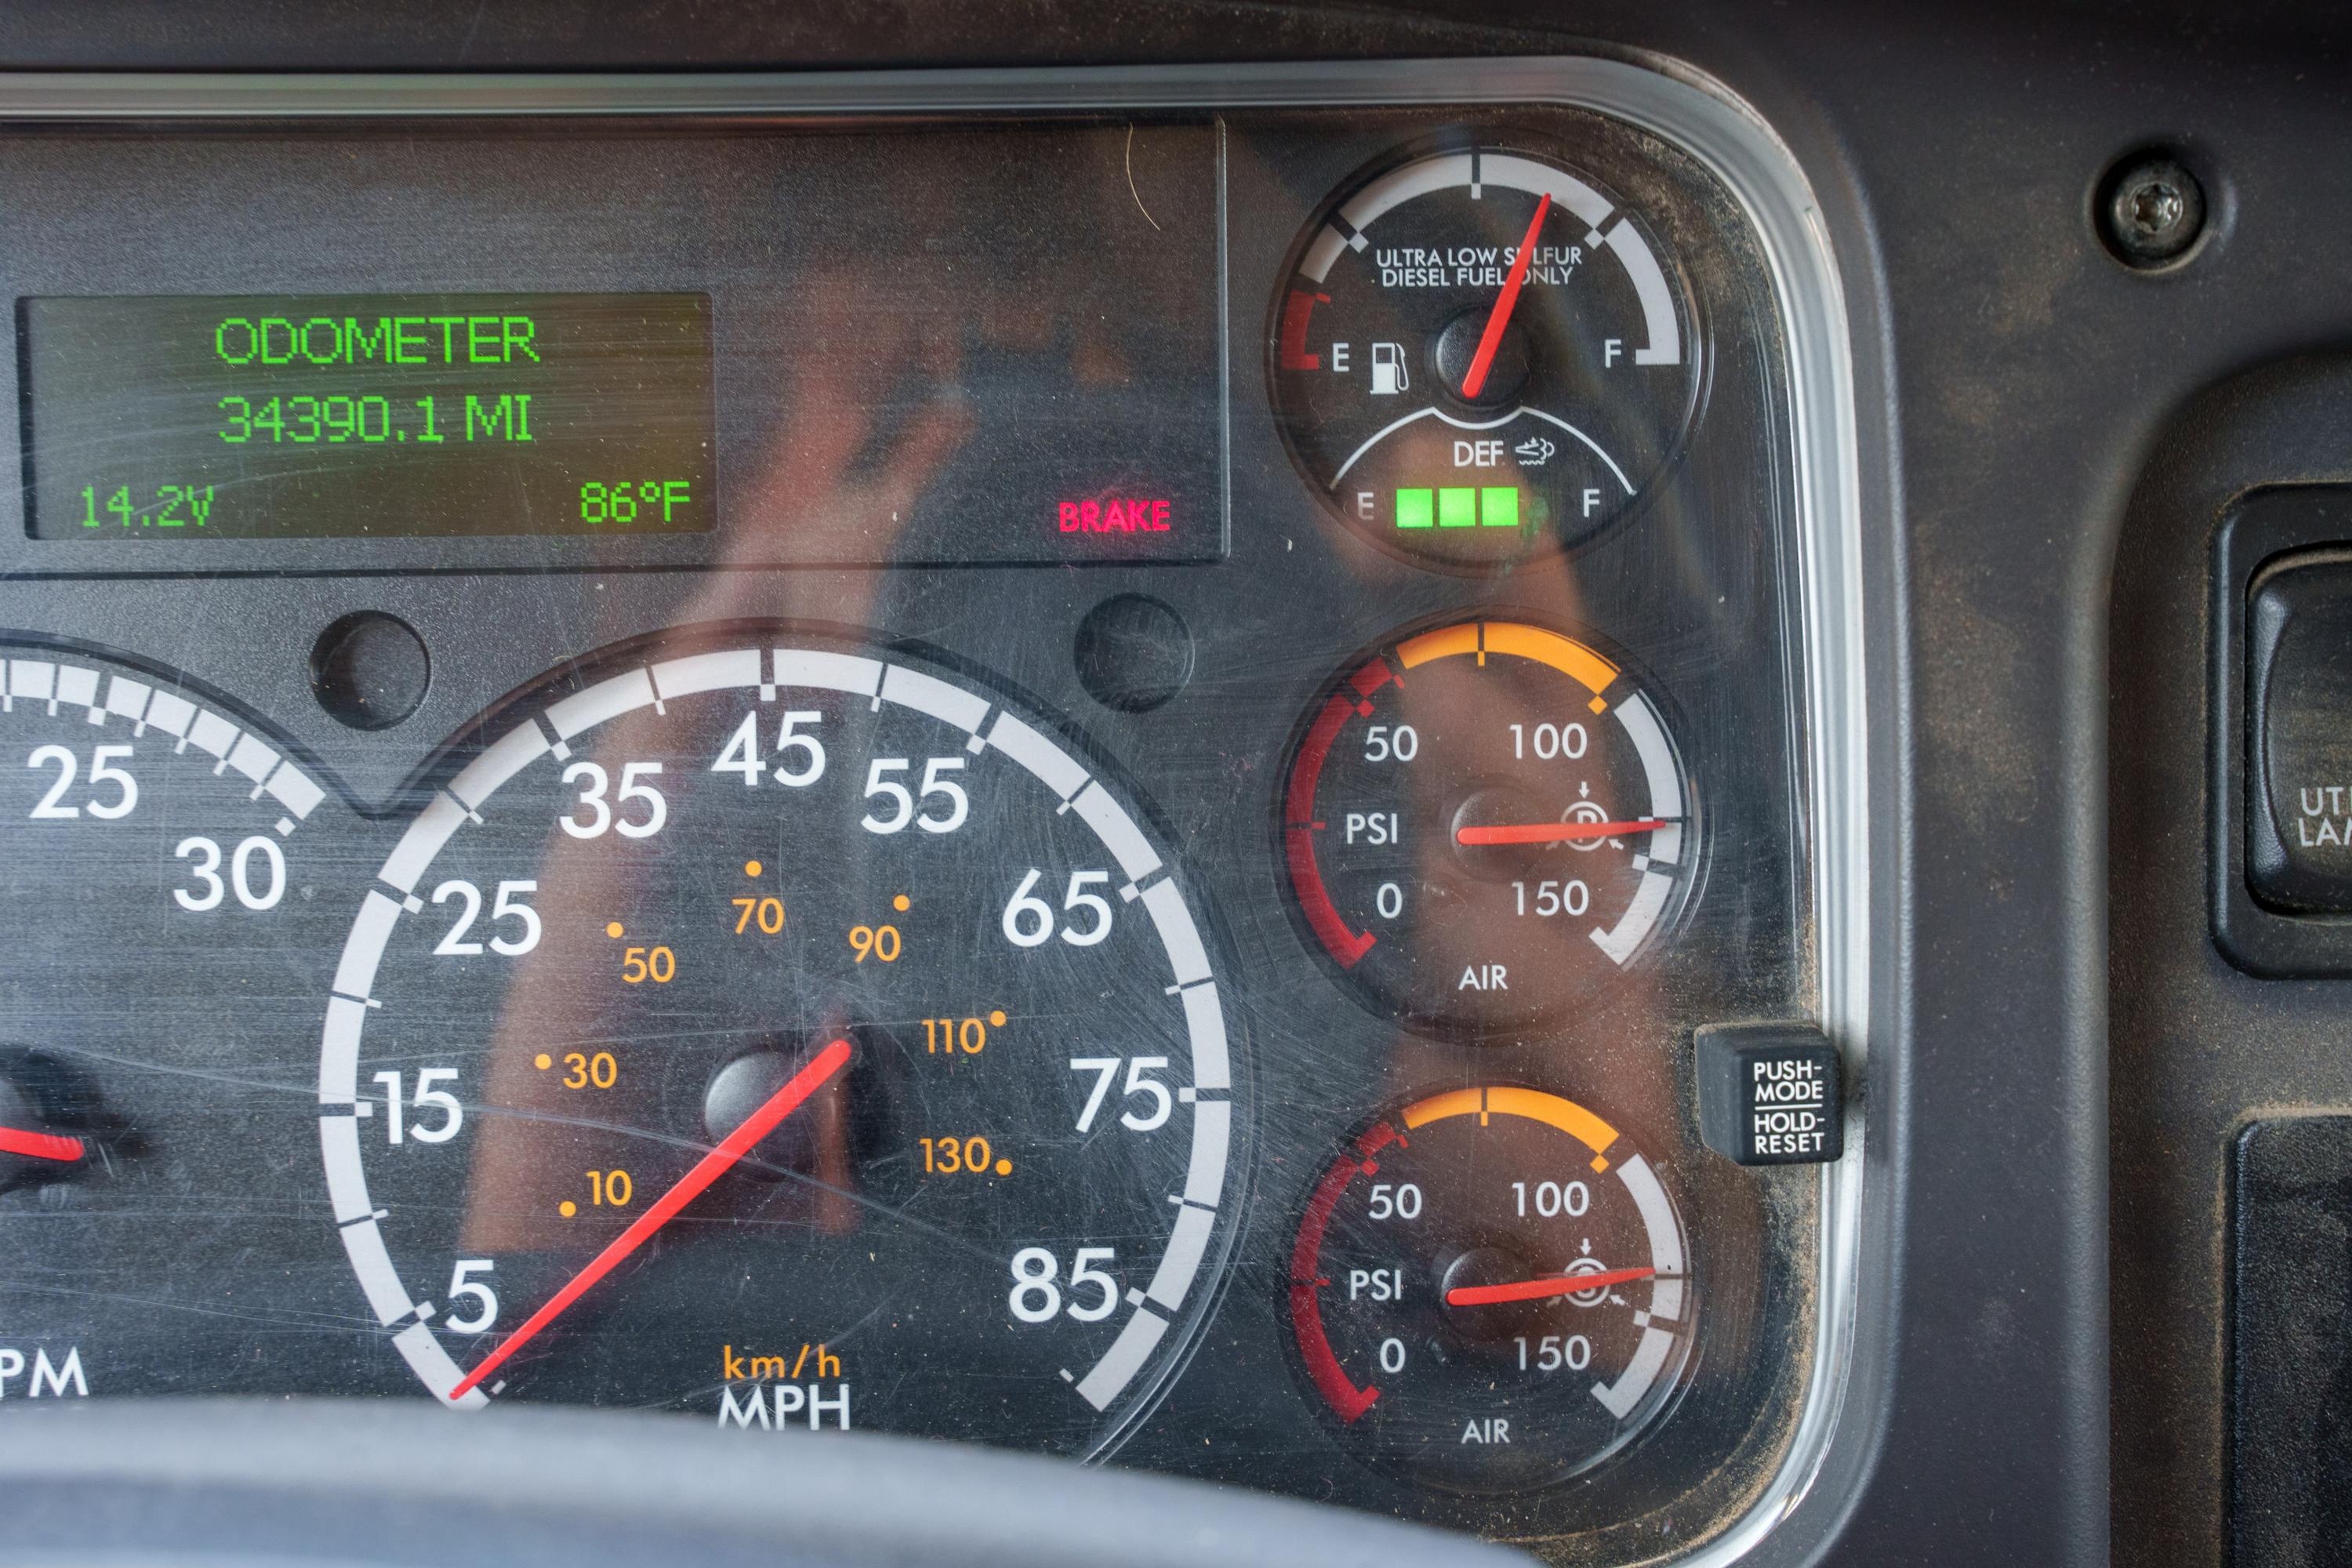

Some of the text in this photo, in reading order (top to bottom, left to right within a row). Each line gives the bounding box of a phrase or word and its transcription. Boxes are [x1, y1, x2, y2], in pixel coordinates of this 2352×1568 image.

[1376, 246, 1583, 268] ULTRA LOW SLFUR
[1381, 268, 1450, 288] DIESEL
[1457, 267, 1506, 287] FUEL
[216, 316, 540, 365] ODOMETER
[1333, 342, 1349, 372] E
[1604, 339, 1622, 368] F
[218, 394, 533, 444] 34390.1 MI
[1453, 440, 1504, 467] DEF
[81, 485, 214, 528] 14.2V
[1058, 500, 1171, 533] BRAKE
[1357, 492, 1374, 521] E
[1583, 488, 1600, 517] F
[710, 710, 826, 787] 45
[1364, 724, 1418, 762] 50
[1509, 722, 1588, 760] 100
[27, 744, 139, 819] 25
[860, 757, 969, 835] 55
[560, 761, 668, 840] 35
[2300, 786, 2352, 816] UT
[1345, 812, 1399, 845] PSI
[173, 835, 287, 912] 30
[731, 897, 784, 935] 70
[1002, 867, 1112, 947] 65
[1376, 882, 1403, 920] 0
[1512, 880, 1589, 917] 150
[431, 879, 543, 956] 25
[848, 924, 902, 963] 90
[622, 946, 677, 983] 50
[1458, 964, 1509, 991] AIR
[921, 1018, 986, 1054] 110
[563, 1052, 618, 1089] 30
[1754, 1059, 1823, 1082] PUSH-
[372, 1067, 463, 1145] 15
[1069, 1056, 1173, 1134] 75
[1755, 1080, 1824, 1102] MODE
[1754, 1112, 1825, 1134] HOLD-
[918, 1136, 990, 1174] 130
[1755, 1132, 1825, 1155] RESET
[586, 1170, 633, 1207] 10
[1368, 1183, 1423, 1220] 50
[1512, 1181, 1590, 1218] 100
[445, 1259, 499, 1334] 5
[1008, 1247, 1120, 1323] 85
[1349, 1269, 1402, 1301] PSI
[724, 1343, 841, 1380] km/h
[1379, 1337, 1406, 1374] 0
[1513, 1334, 1591, 1372] 150
[717, 1384, 851, 1431] MPH
[1461, 1418, 1511, 1445] AIR
